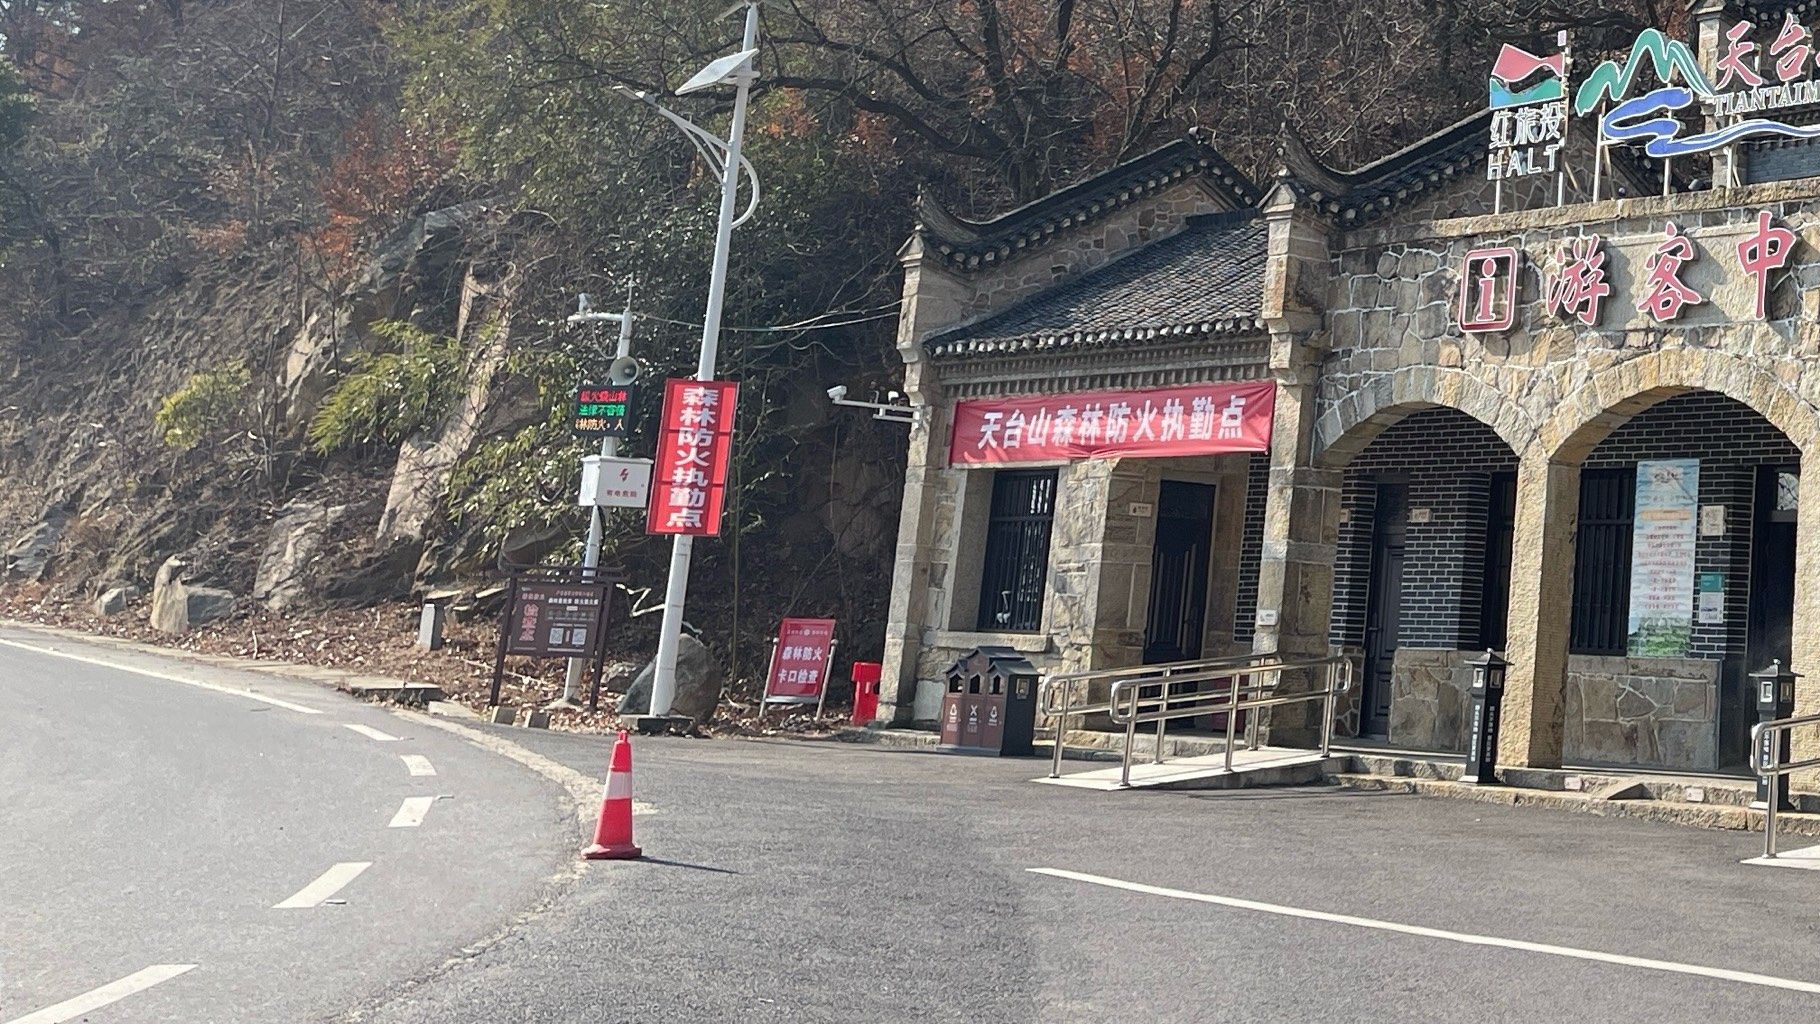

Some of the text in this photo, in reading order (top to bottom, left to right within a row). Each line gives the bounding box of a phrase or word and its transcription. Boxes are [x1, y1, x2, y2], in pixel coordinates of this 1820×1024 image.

[1489, 102, 1565, 149] 红旅投
[1487, 144, 1560, 180] HALT
[977, 395, 1246, 449] 天台山森林防火执勤点
[665, 386, 719, 528] 森林防火执勤点
[782, 646, 823, 661] 森林防火
[778, 668, 819, 684] 卡口检查
